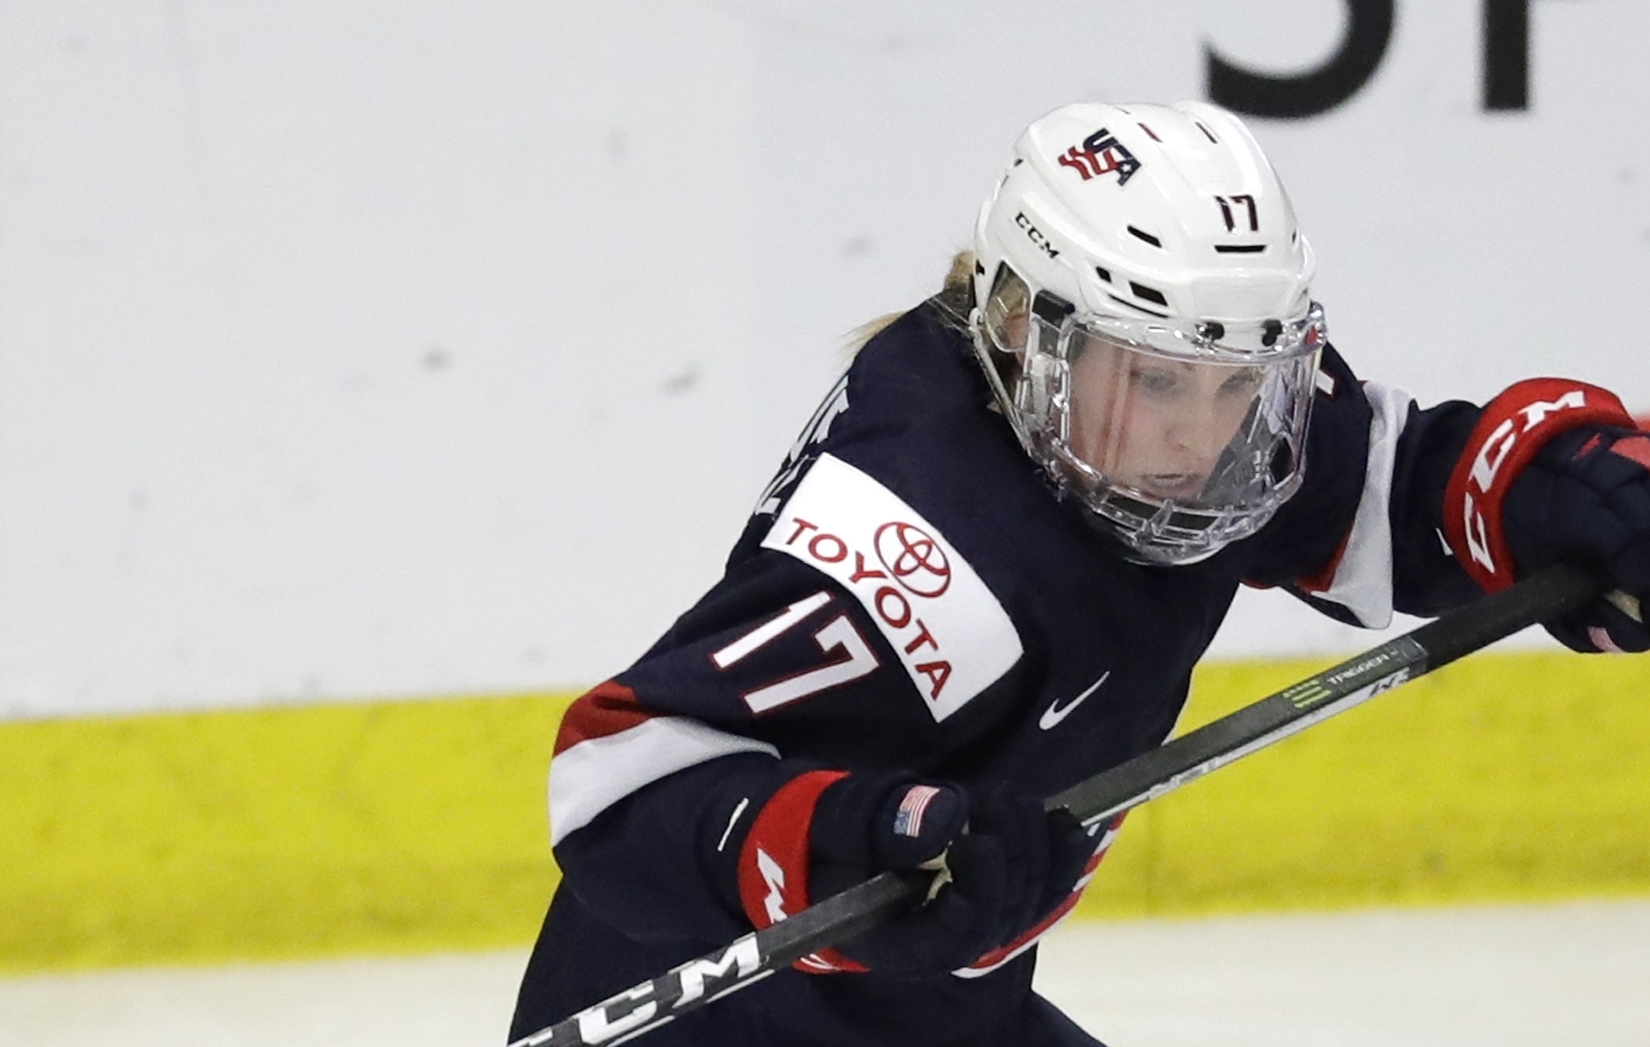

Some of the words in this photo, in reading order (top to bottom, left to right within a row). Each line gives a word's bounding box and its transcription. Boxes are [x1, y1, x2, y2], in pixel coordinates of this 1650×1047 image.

[1058, 127, 1142, 187] USA
[1014, 211, 1060, 260] CCM
[1213, 194, 1259, 232] 17
[1464, 391, 1587, 574] CCM
[709, 590, 879, 716] 17
[784, 517, 954, 701] TOYOTA
